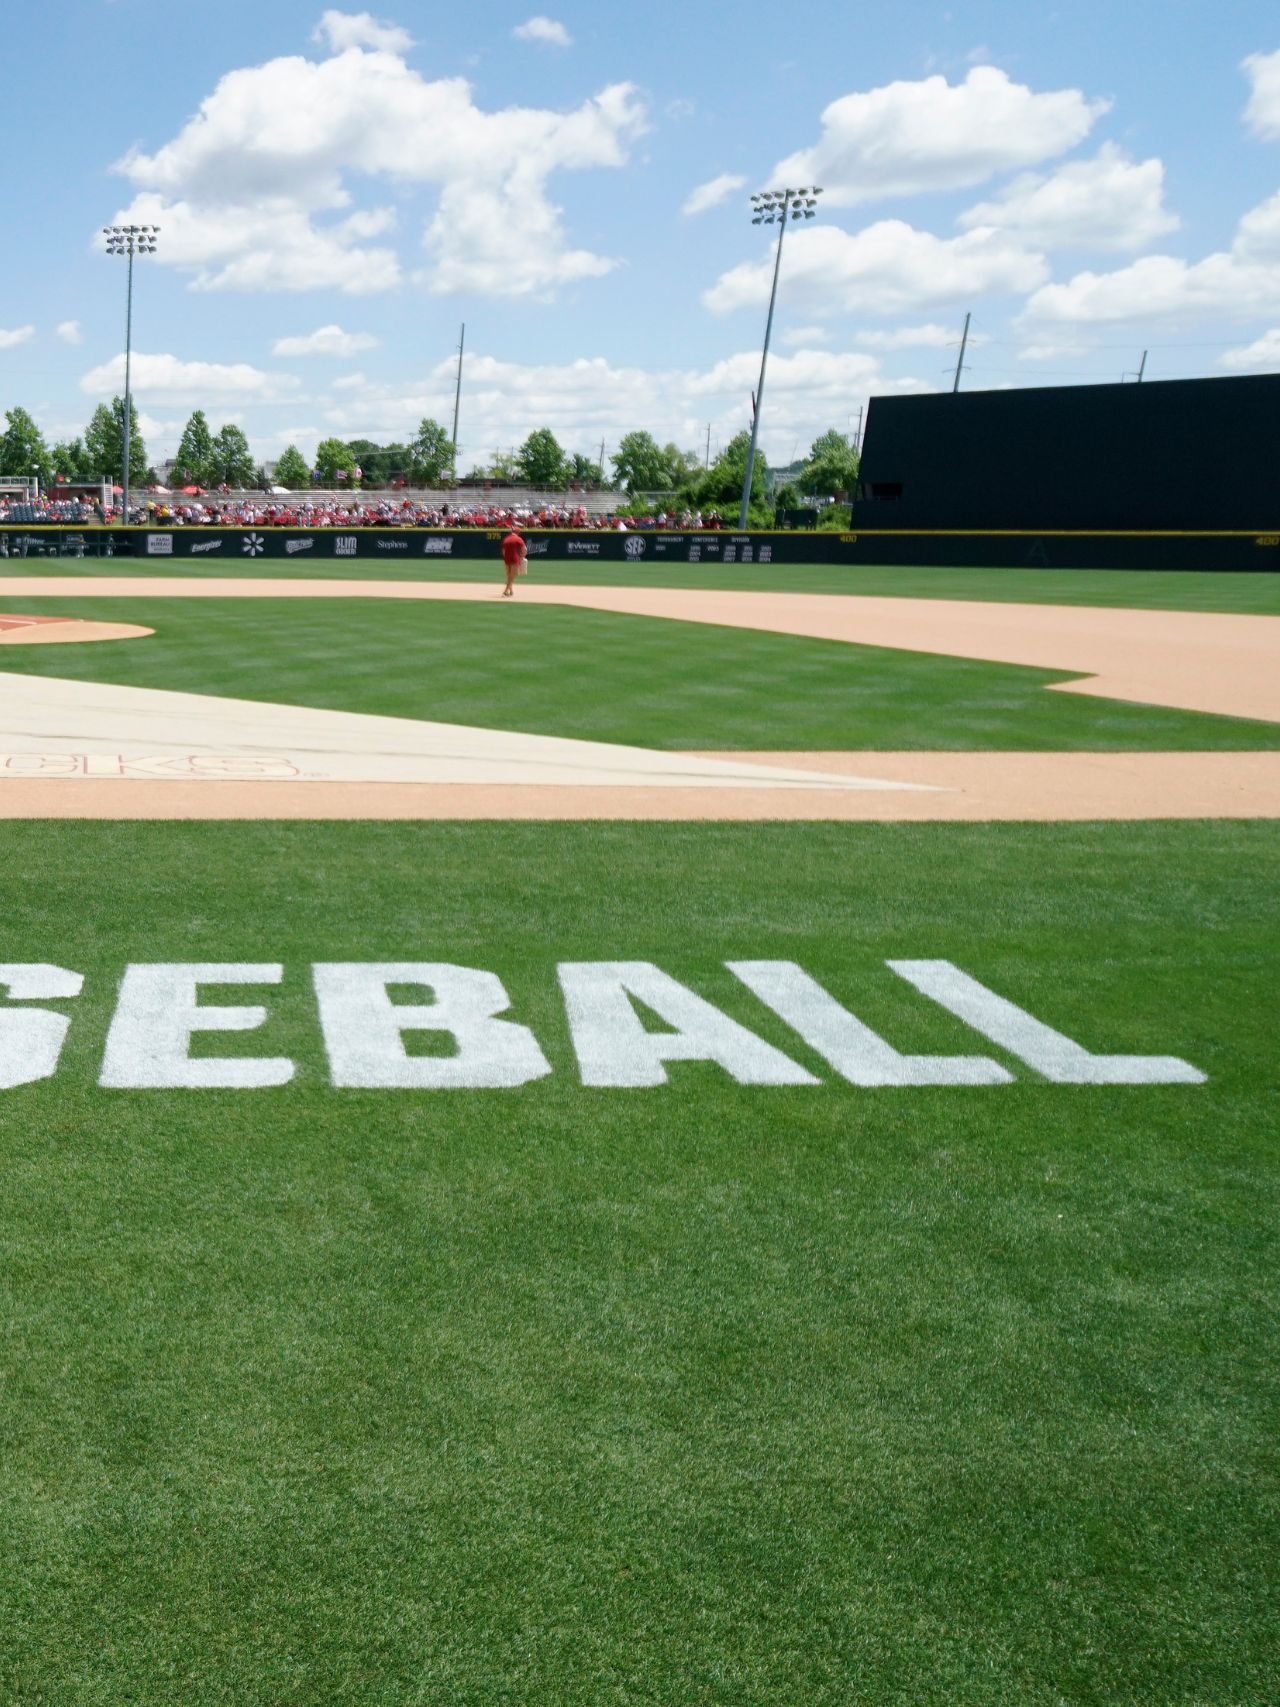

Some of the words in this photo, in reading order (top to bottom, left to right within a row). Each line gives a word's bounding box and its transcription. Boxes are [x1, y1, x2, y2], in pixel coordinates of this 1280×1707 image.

[336, 537, 357, 549] SLIM
[840, 535, 858, 543] 400
[1255, 536, 1280, 546] 400
[191, 540, 222, 553] Energizer
[376, 540, 408, 550] Stephens
[568, 542, 601, 550] EVERETT
